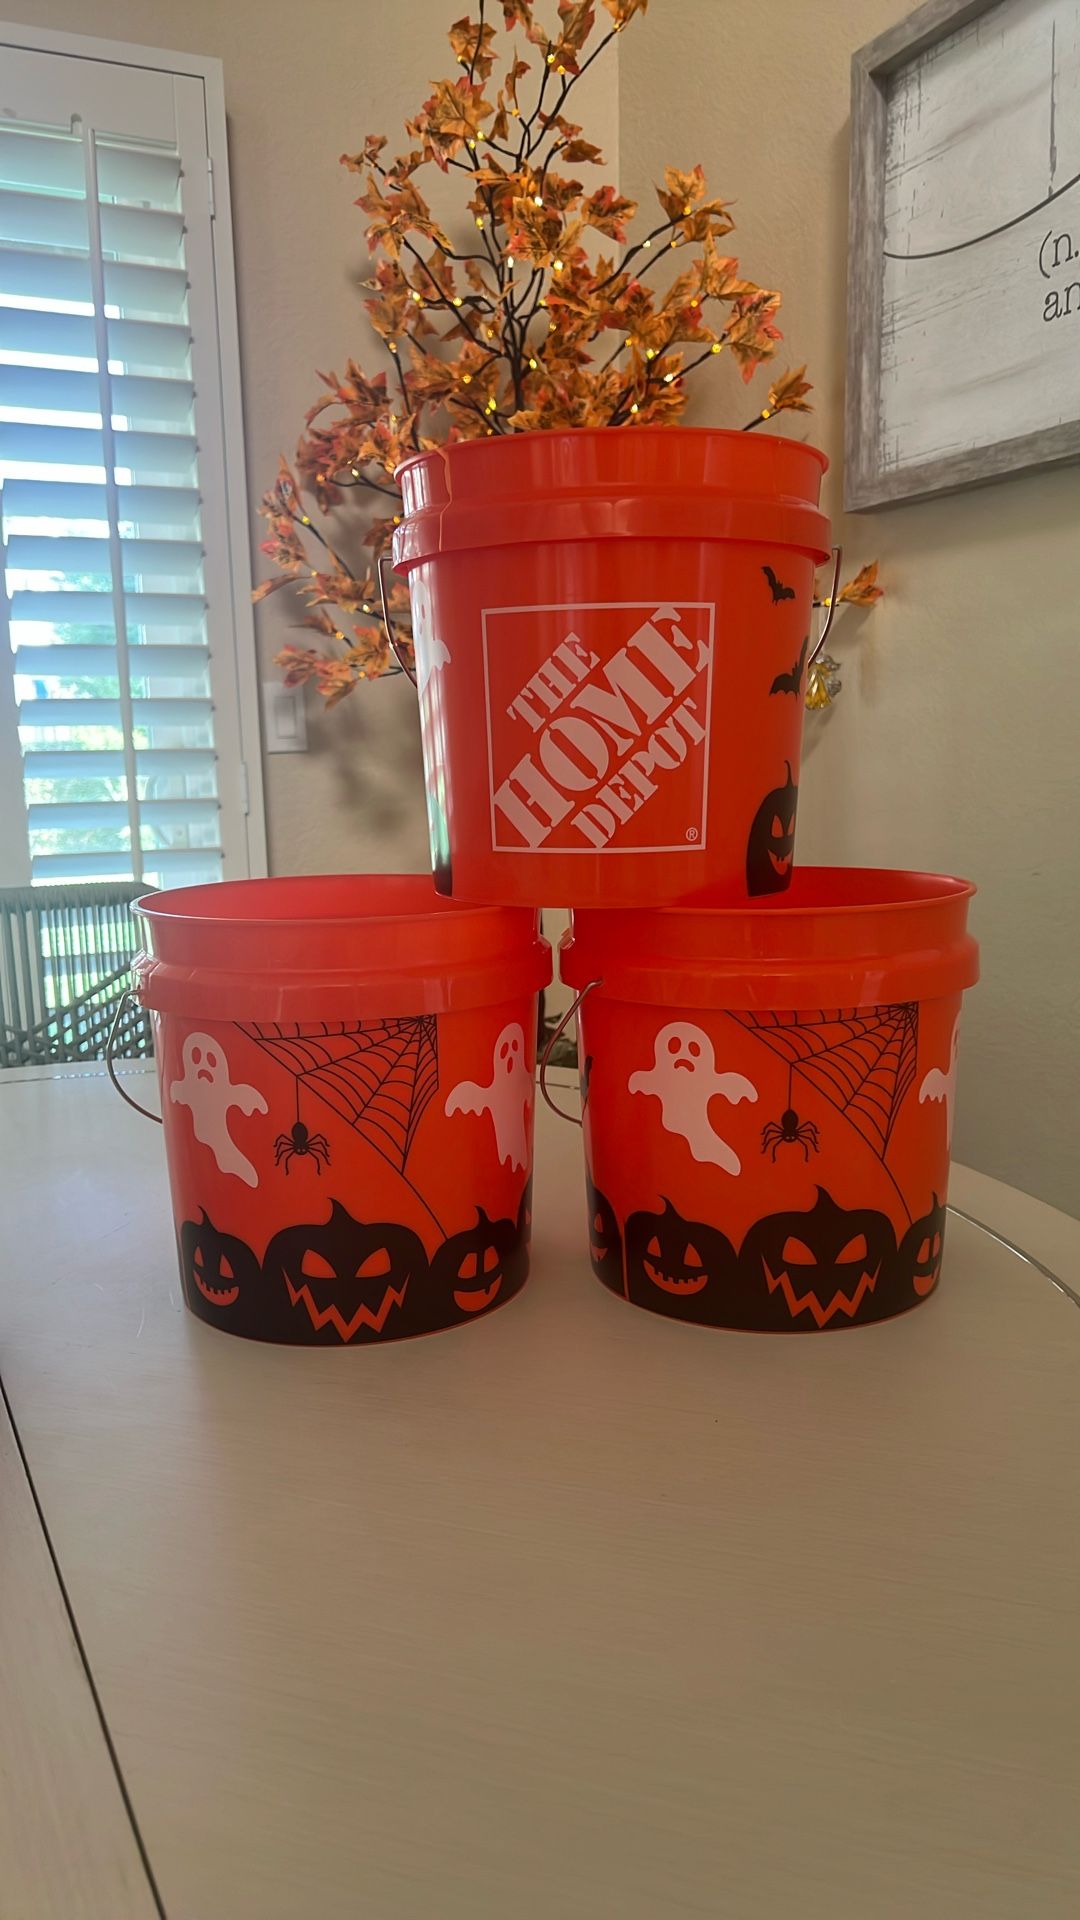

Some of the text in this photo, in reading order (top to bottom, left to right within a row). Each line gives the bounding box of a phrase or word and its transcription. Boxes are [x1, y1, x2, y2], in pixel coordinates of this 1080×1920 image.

[494, 606, 709, 849] HOME
[506, 631, 601, 733] THE
[570, 697, 706, 849] DEPOT
